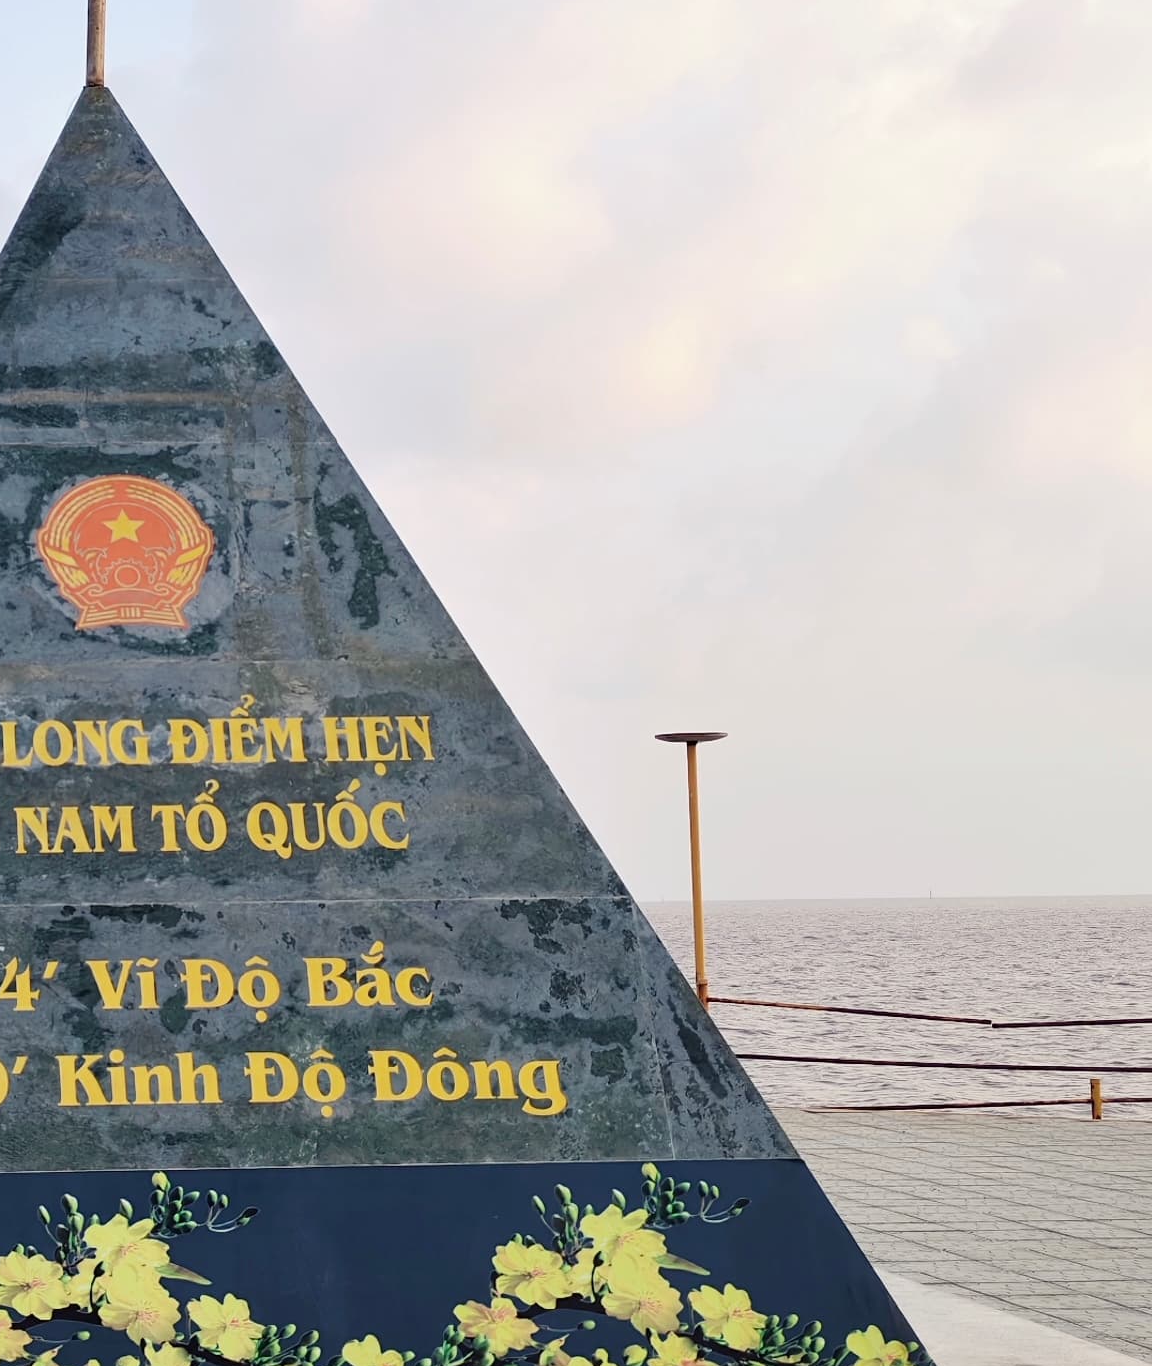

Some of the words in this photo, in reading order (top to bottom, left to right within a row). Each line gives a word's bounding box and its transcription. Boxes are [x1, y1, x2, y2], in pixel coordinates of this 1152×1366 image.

[1, 718, 151, 768] LONG
[167, 693, 308, 765] ĐIỂM
[322, 715, 435, 778] HẸN
[15, 804, 139, 855] NAM
[150, 778, 229, 853] TỔ
[246, 778, 411, 860] QUỐC
[86, 956, 159, 1011] Vĩ
[180, 955, 282, 1023] Độ
[304, 939, 435, 1009] Bắc
[57, 1048, 223, 1108] Kinh
[244, 1047, 348, 1119] Độ
[368, 1046, 570, 1118] Đông
